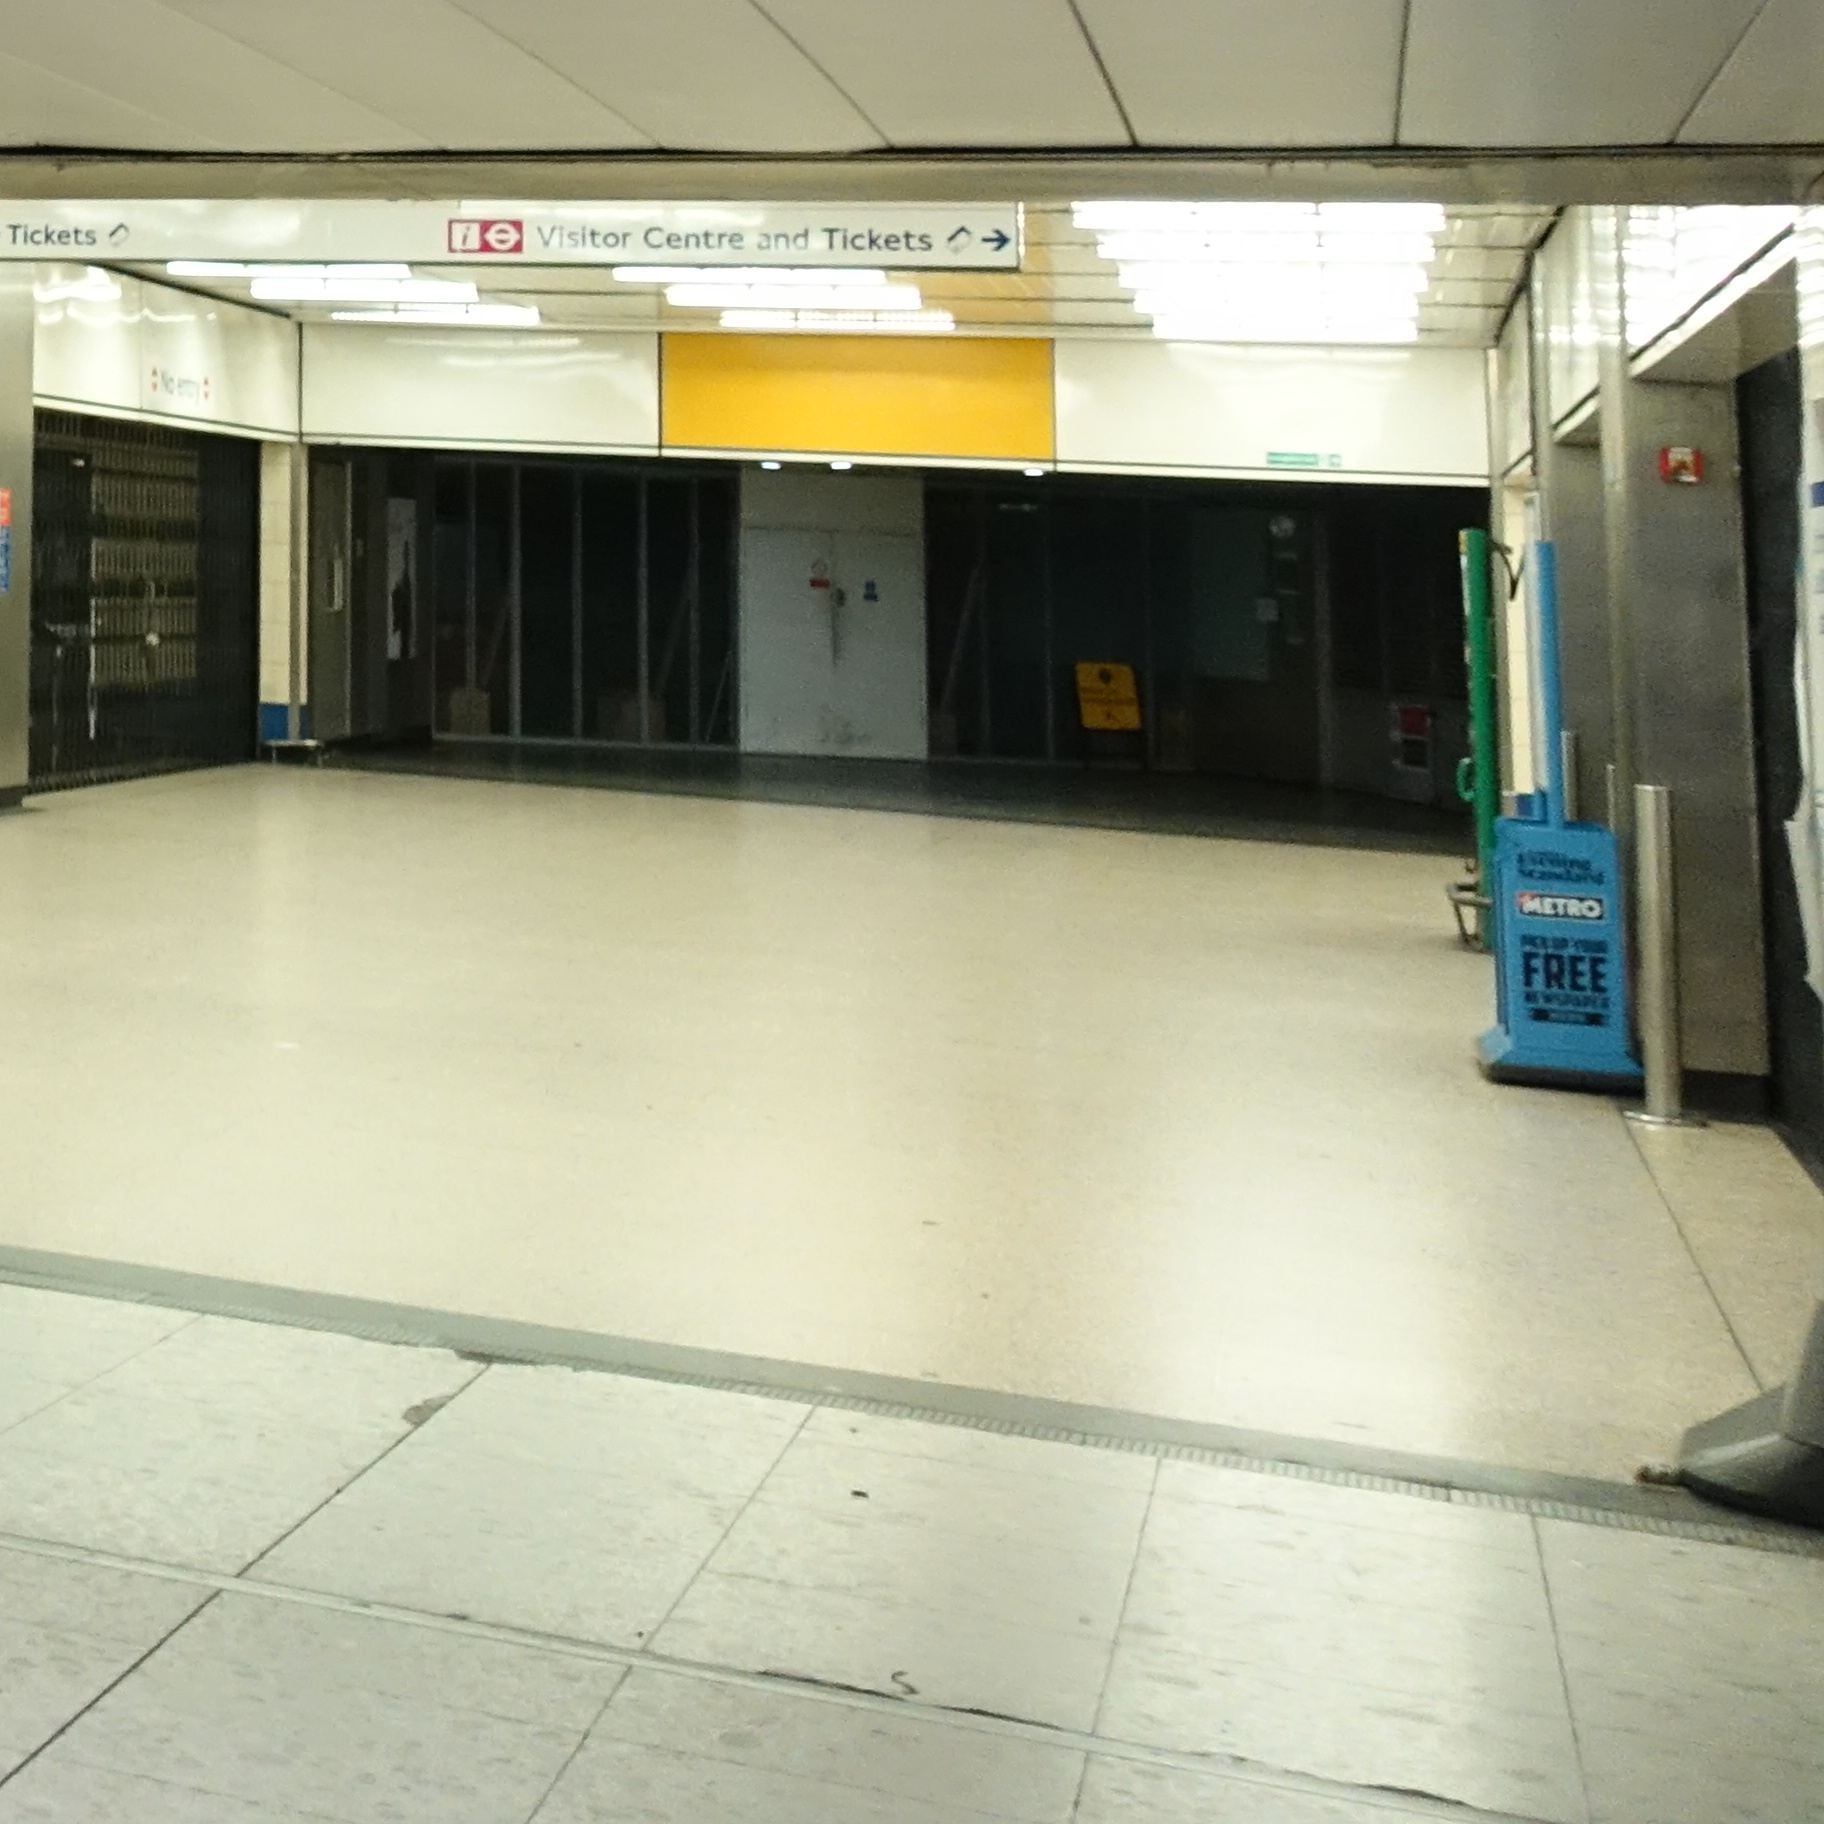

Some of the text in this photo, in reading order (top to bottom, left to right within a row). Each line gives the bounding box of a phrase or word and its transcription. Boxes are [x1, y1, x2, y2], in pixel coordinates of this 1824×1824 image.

[7, 223, 97, 246] Tickets
[536, 226, 632, 249] Visitor
[644, 226, 745, 250] Centre
[757, 228, 809, 250] and
[821, 227, 934, 252] Tickets
[1521, 894, 1602, 918] METRO
[1523, 952, 1607, 993] FREE
